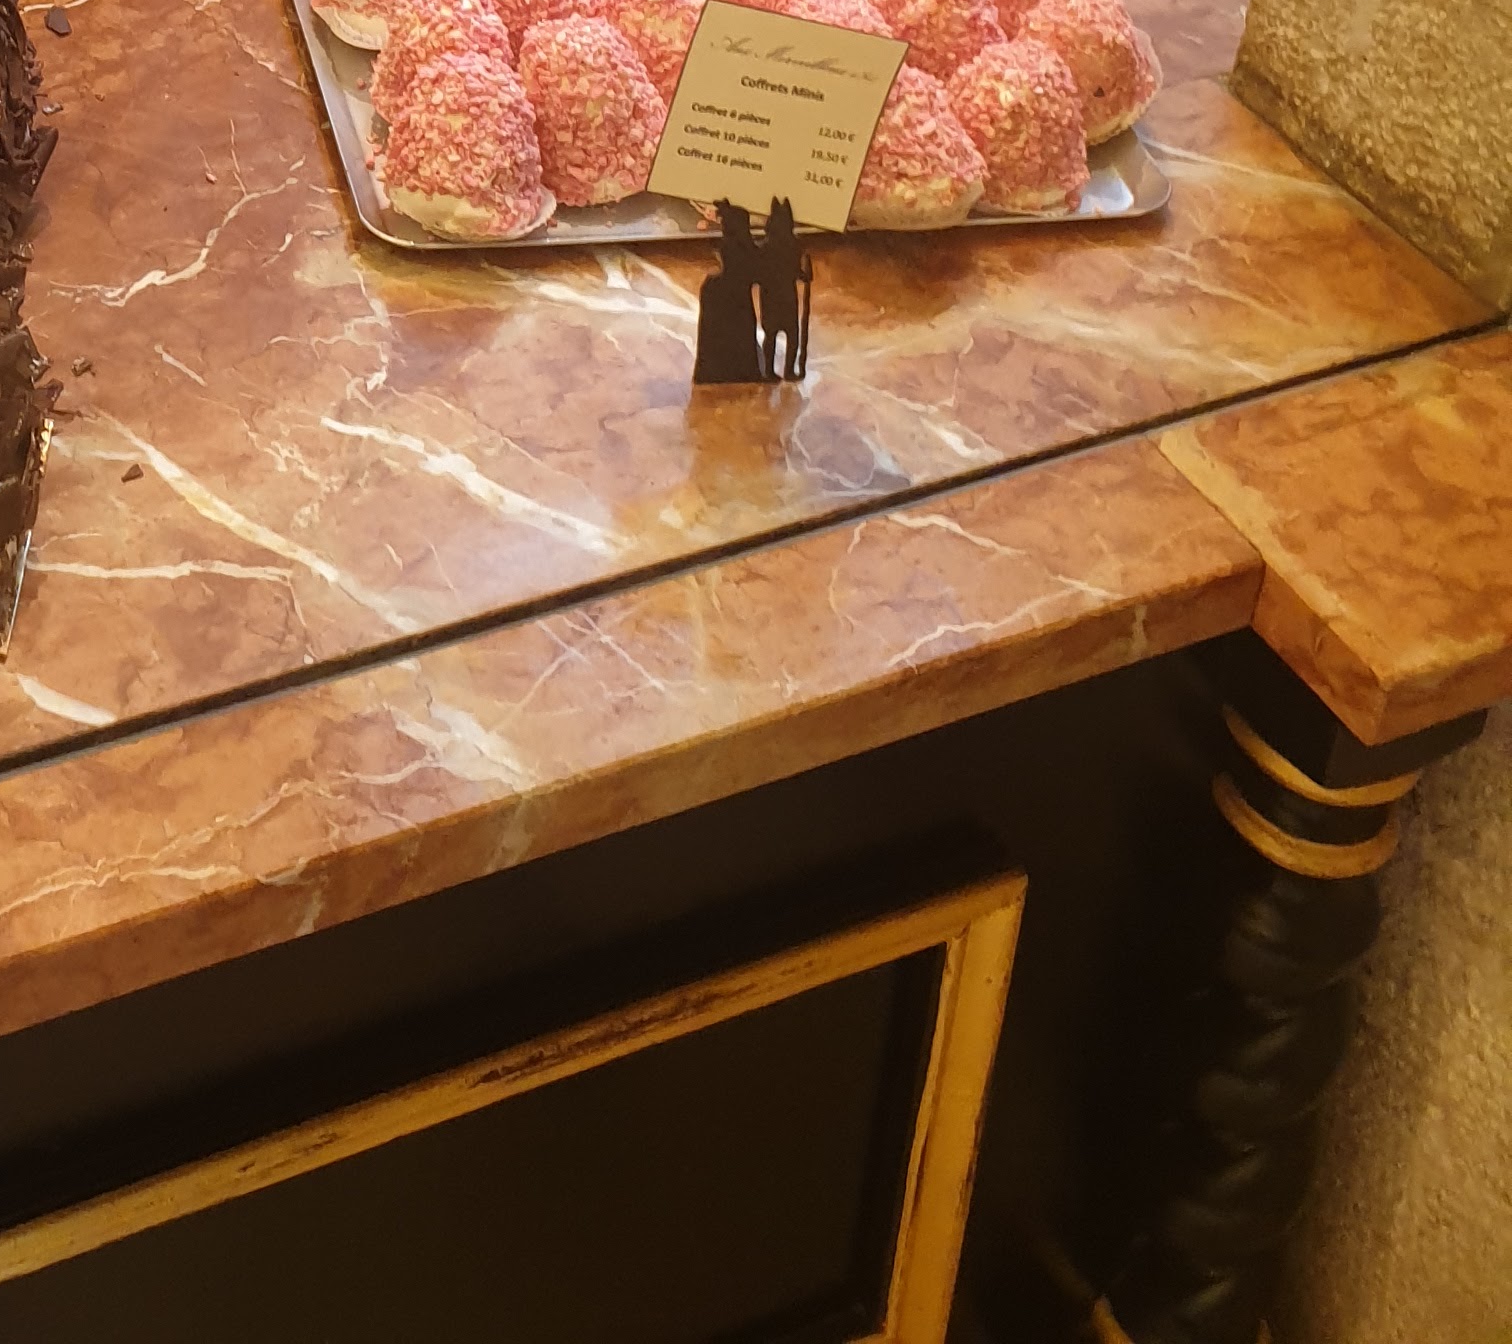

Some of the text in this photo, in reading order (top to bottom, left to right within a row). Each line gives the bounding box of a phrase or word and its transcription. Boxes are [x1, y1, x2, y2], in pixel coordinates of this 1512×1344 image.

[740, 75, 826, 102] Coffrets Minis
[691, 102, 728, 117] Coffret
[683, 124, 721, 140] Coffret
[723, 131, 736, 142] 10
[677, 146, 714, 162] Coffret
